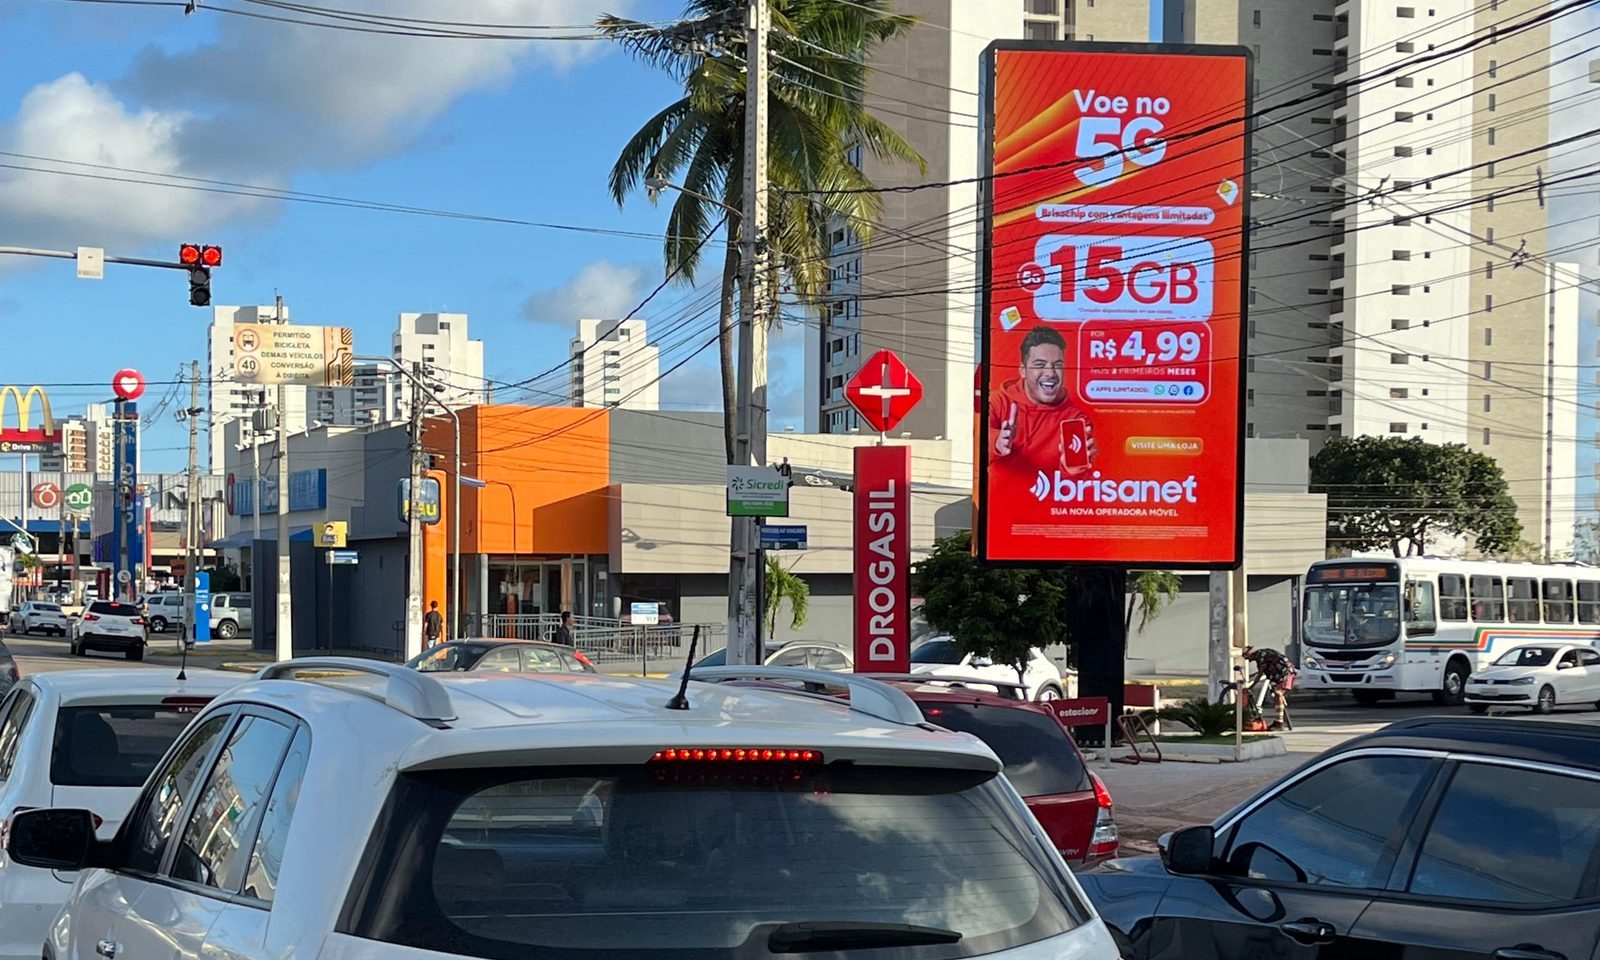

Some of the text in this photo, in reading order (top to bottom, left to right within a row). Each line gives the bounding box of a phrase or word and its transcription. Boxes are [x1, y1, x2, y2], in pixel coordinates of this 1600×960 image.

[1073, 89, 1170, 115] Voe no
[1074, 117, 1167, 188] 5G
[1042, 208, 1086, 220] Brisachip
[1088, 211, 1108, 219] com
[1112, 211, 1159, 221] vantagens
[1023, 271, 1041, 284] 5G
[1090, 331, 1200, 365] R$ 4,99
[289, 351, 323, 359] VEÍCULOS
[242, 360, 256, 370] 40
[271, 361, 314, 369] CONVERSÃO
[12, 443, 47, 451] Drive Thru
[1177, 442, 1198, 450] LOJA
[746, 479, 784, 490] Sicredi
[1054, 470, 1197, 502] brisanet
[1069, 508, 1094, 516] NOVA
[1095, 508, 1147, 516] OPERADORA
[1149, 507, 1178, 517] MÓVEL
[869, 479, 895, 661] DROGASIL
